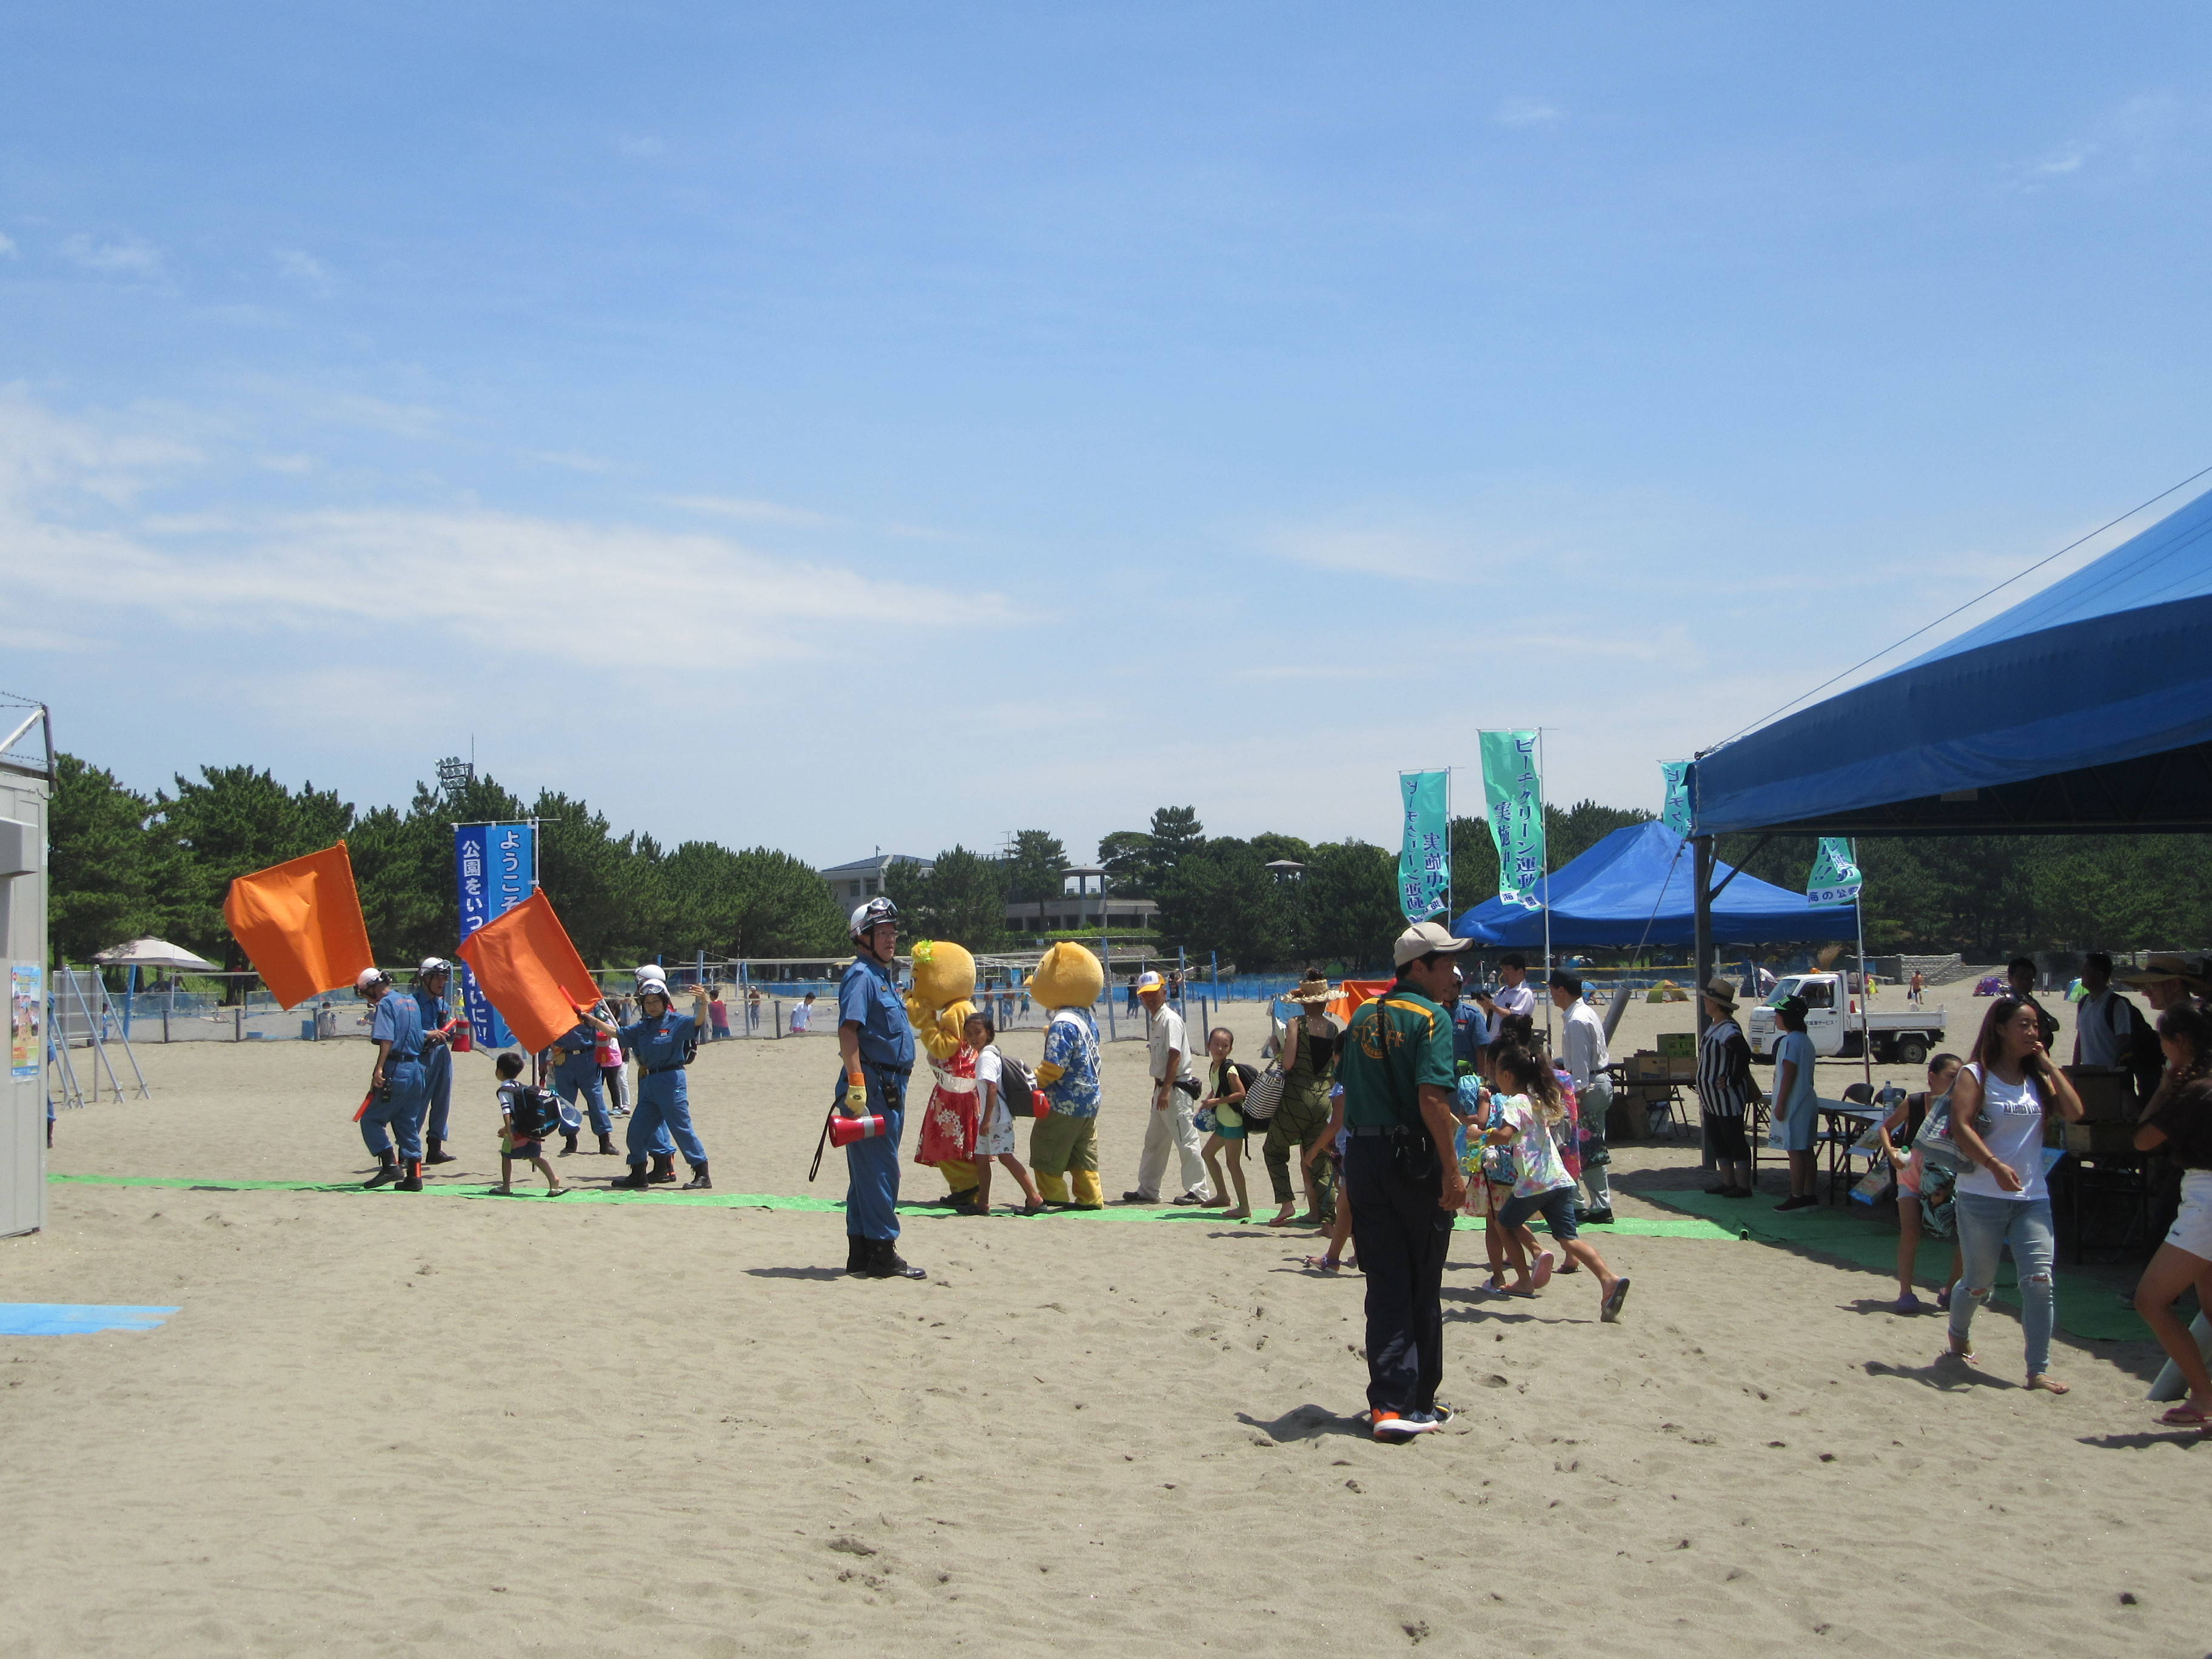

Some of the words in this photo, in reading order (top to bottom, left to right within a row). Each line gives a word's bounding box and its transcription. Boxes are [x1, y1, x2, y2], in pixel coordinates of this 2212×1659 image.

[1514, 737, 1538, 890] ビーチクリーン運動
[1352, 1025, 1406, 1047] STAFF
